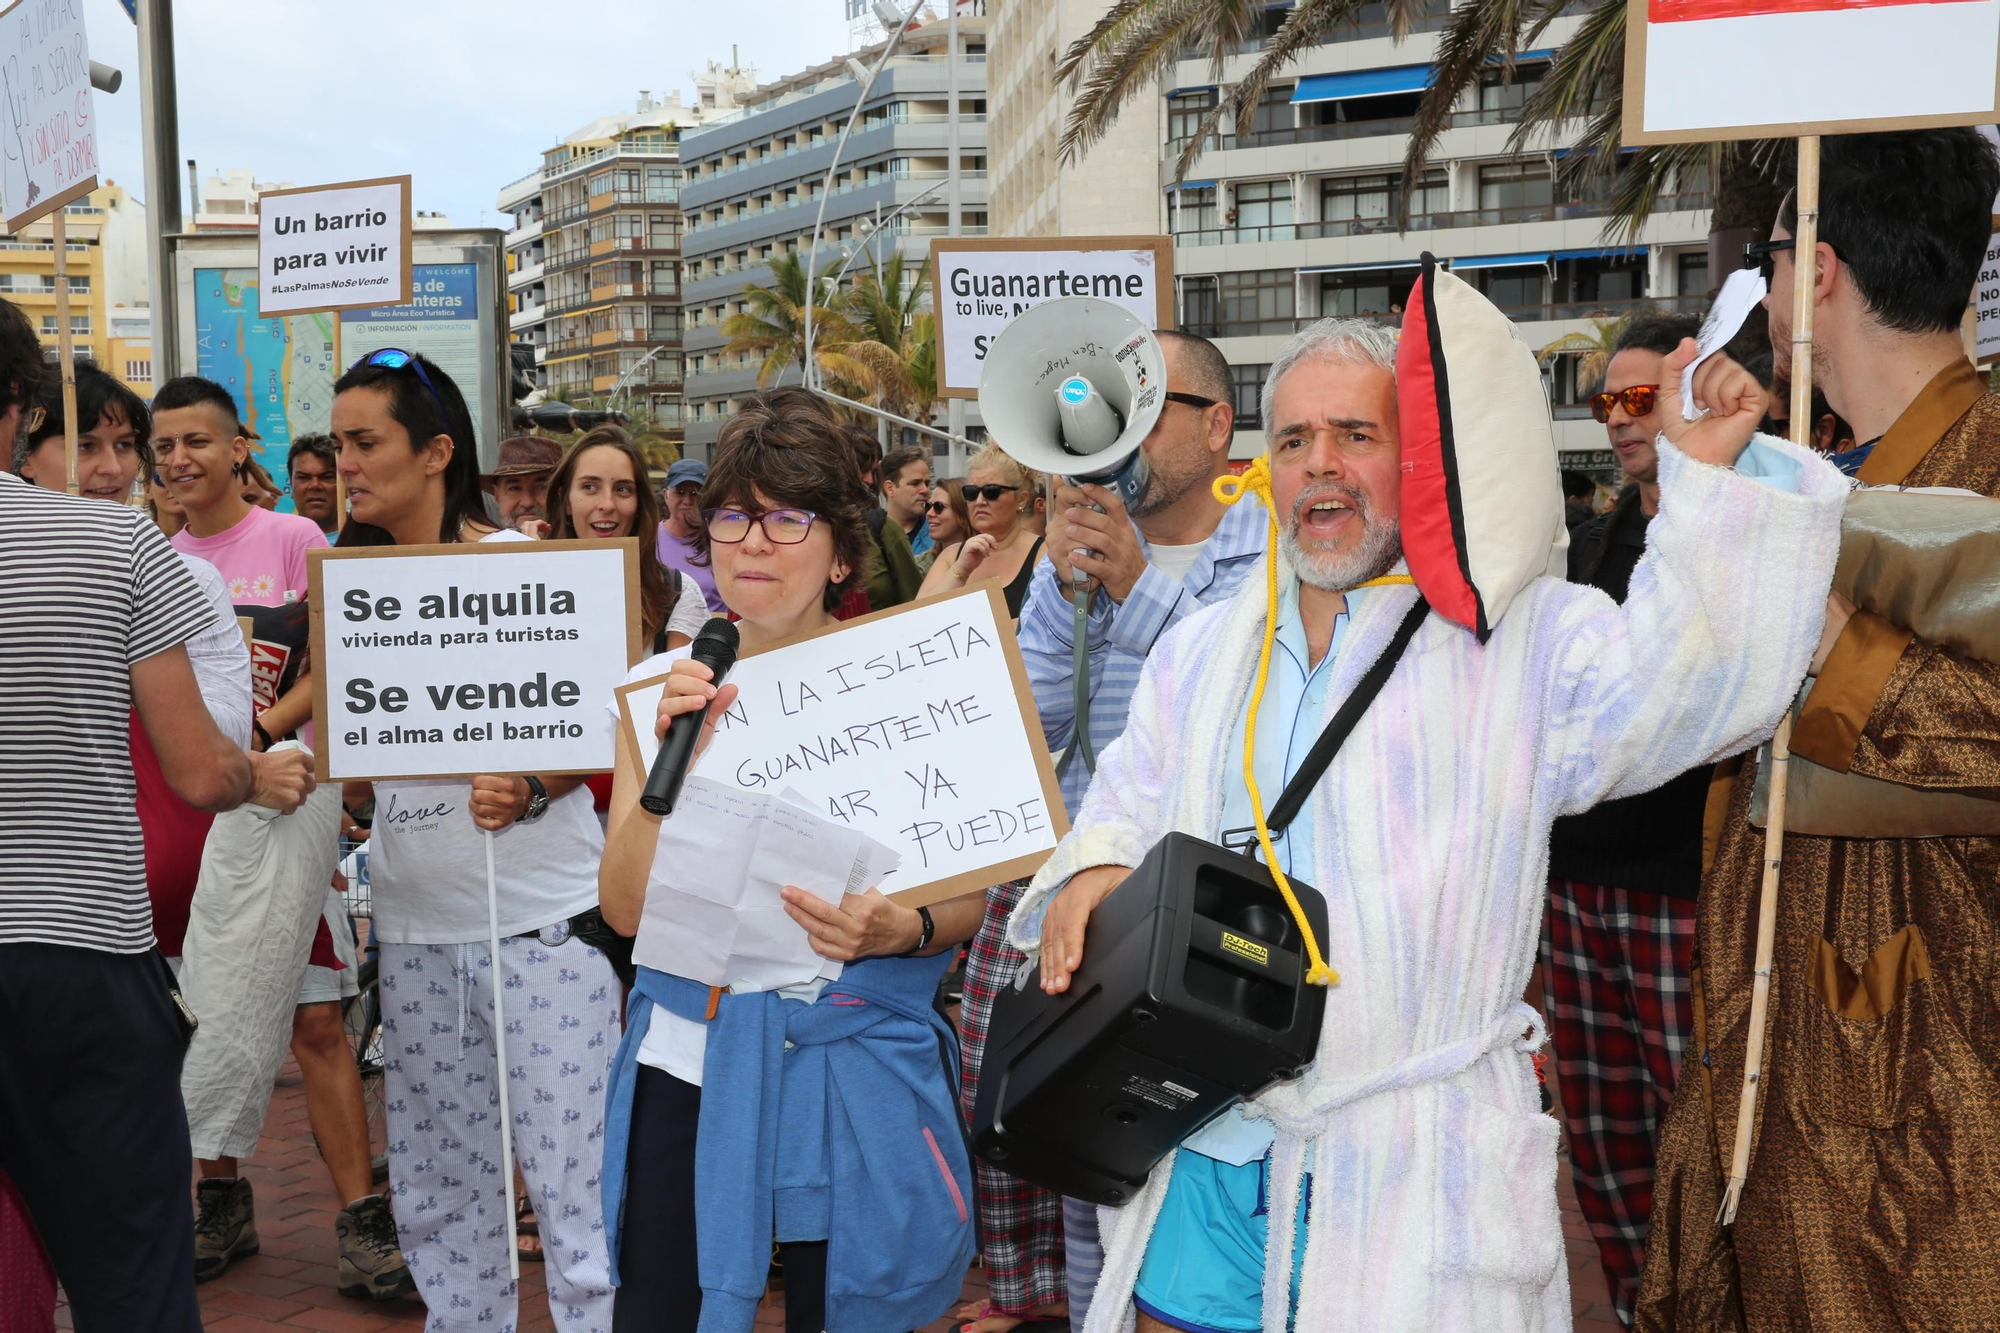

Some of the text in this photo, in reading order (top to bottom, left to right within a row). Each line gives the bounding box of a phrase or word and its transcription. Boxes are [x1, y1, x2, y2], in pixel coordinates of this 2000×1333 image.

[48, 32, 87, 96] SERVIR
[274, 207, 387, 236] Un barrio
[273, 243, 388, 276] para vivir
[425, 268, 471, 276] WELCOME
[271, 276, 389, 294] #LasPalmasNoSeVende
[425, 278, 445, 293] de
[950, 267, 1144, 297] Guanarteme
[1980, 288, 1999, 302] NO
[371, 310, 391, 318] Micro
[956, 300, 972, 316] to
[976, 299, 1008, 319] live,
[367, 324, 418, 332] INFORMACIÓN
[974, 335, 996, 361] S
[1559, 450, 1616, 464] ires Gri
[343, 583, 576, 626] Se alquila
[342, 626, 579, 649] vivienda para turistas
[777, 680, 822, 716] LA
[826, 622, 991, 695] ISLETA
[344, 672, 581, 715] Se vende
[344, 719, 583, 746] el alma del barrio
[736, 695, 992, 789] GUANARTEME
[828, 762, 959, 823] AR YA
[385, 793, 455, 824] love
[394, 822, 439, 835] the journey
[899, 797, 1046, 868] PUEDE
[1224, 934, 1267, 956] DJ-Tech
[1224, 941, 1267, 964] Professional
